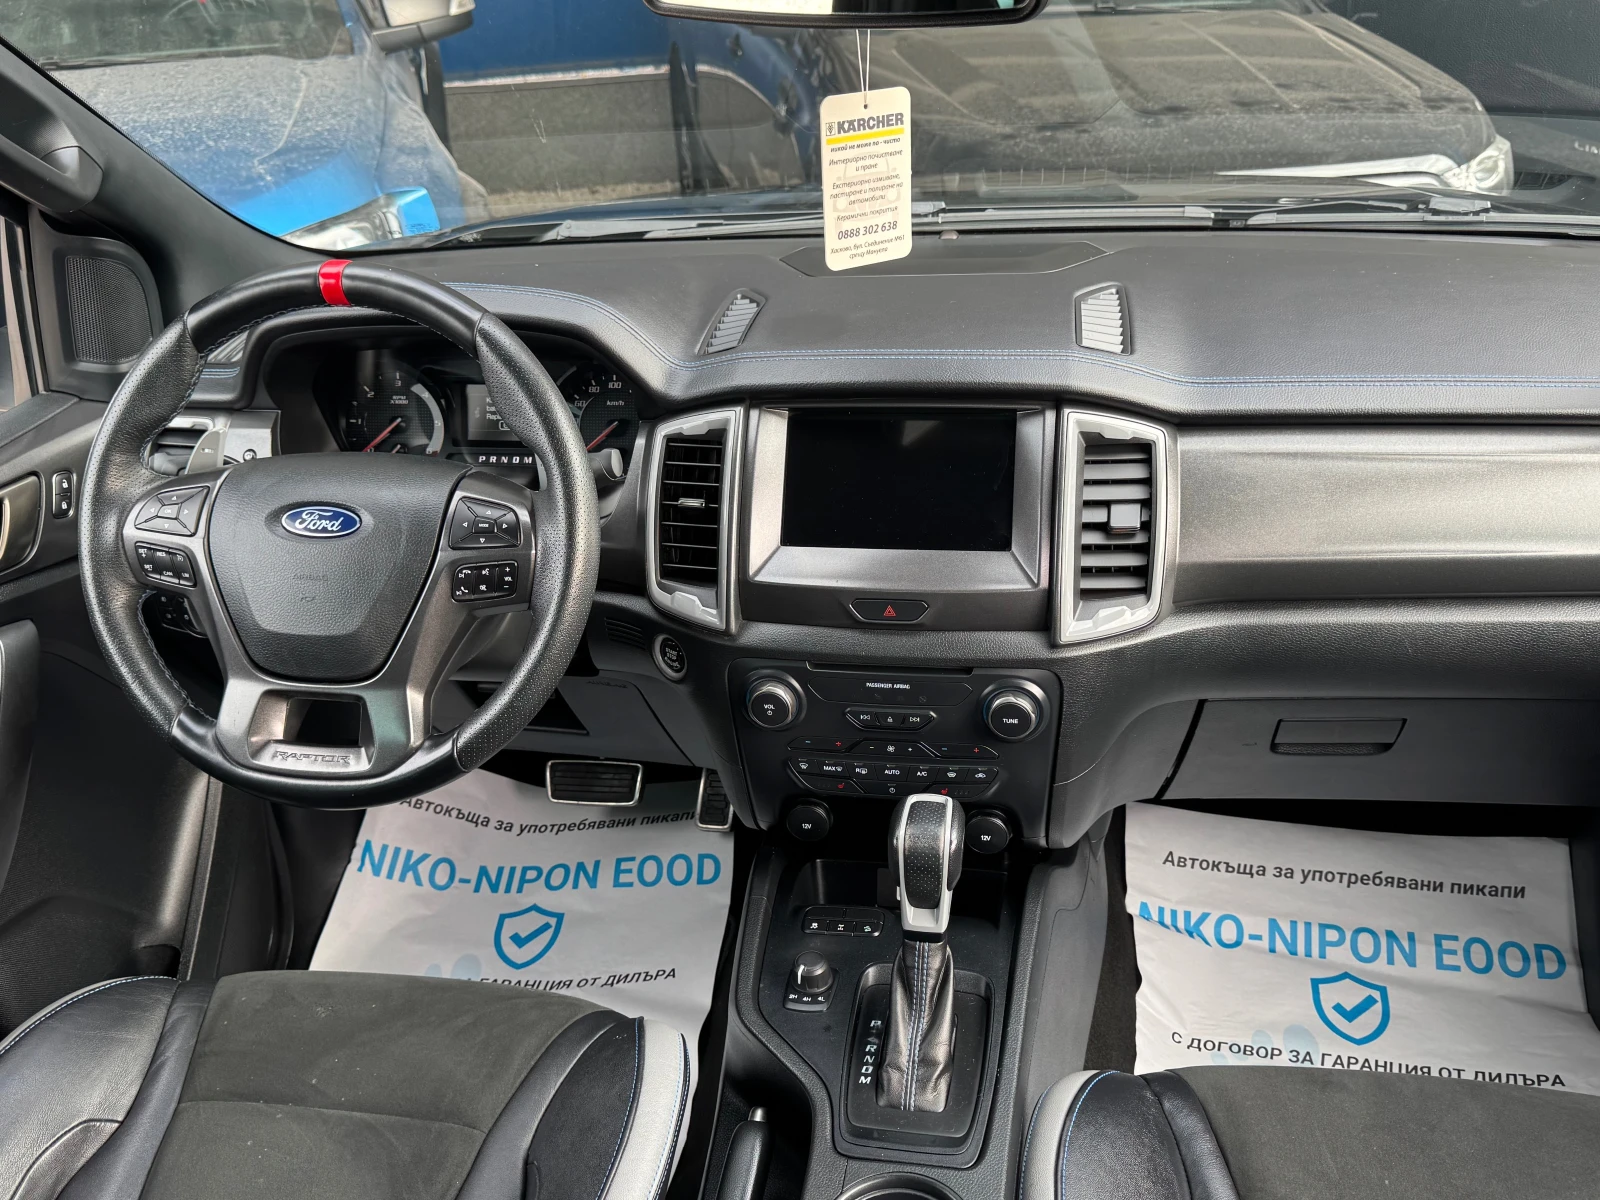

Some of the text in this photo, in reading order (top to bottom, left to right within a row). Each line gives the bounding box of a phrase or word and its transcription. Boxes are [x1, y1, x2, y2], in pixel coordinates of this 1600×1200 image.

[836, 112, 904, 135] KÄRCHER
[831, 144, 848, 153] никой
[856, 141, 872, 149] може
[883, 137, 901, 145] чисто
[829, 149, 904, 167] Интериорно почистване
[861, 163, 879, 172] пране
[830, 188, 863, 200] пастиране
[868, 183, 896, 193] полиране
[832, 178, 872, 190] Екстериорно
[848, 193, 886, 206] автомобили
[837, 205, 899, 222] Керамични покрития
[837, 220, 898, 241] 0888 302 638
[864, 238, 894, 249] Съединение
[608, 381, 622, 389] 100
[478, 455, 533, 464] P R N D M
[294, 508, 342, 533] Ford
[1002, 717, 1019, 725] TUNE
[271, 750, 351, 766] RAPTOR
[494, 818, 514, 833] за
[516, 815, 637, 836] употребявани
[356, 838, 722, 895] NIKO-NIPON EOOD
[1162, 850, 1527, 900] Автокъща за употребявани пикапи
[1434, 934, 1568, 981] EOOD
[576, 974, 599, 988] ОТ
[600, 967, 677, 988] ДИЛЪРА
[859, 1019, 881, 1084] P R N D M
[1187, 1037, 1283, 1061] ДОГОВОР
[1287, 1048, 1315, 1067] ЗА
[1320, 1053, 1432, 1078] ГАРАНЦИЯ
[1438, 1066, 1466, 1079] ОТ
